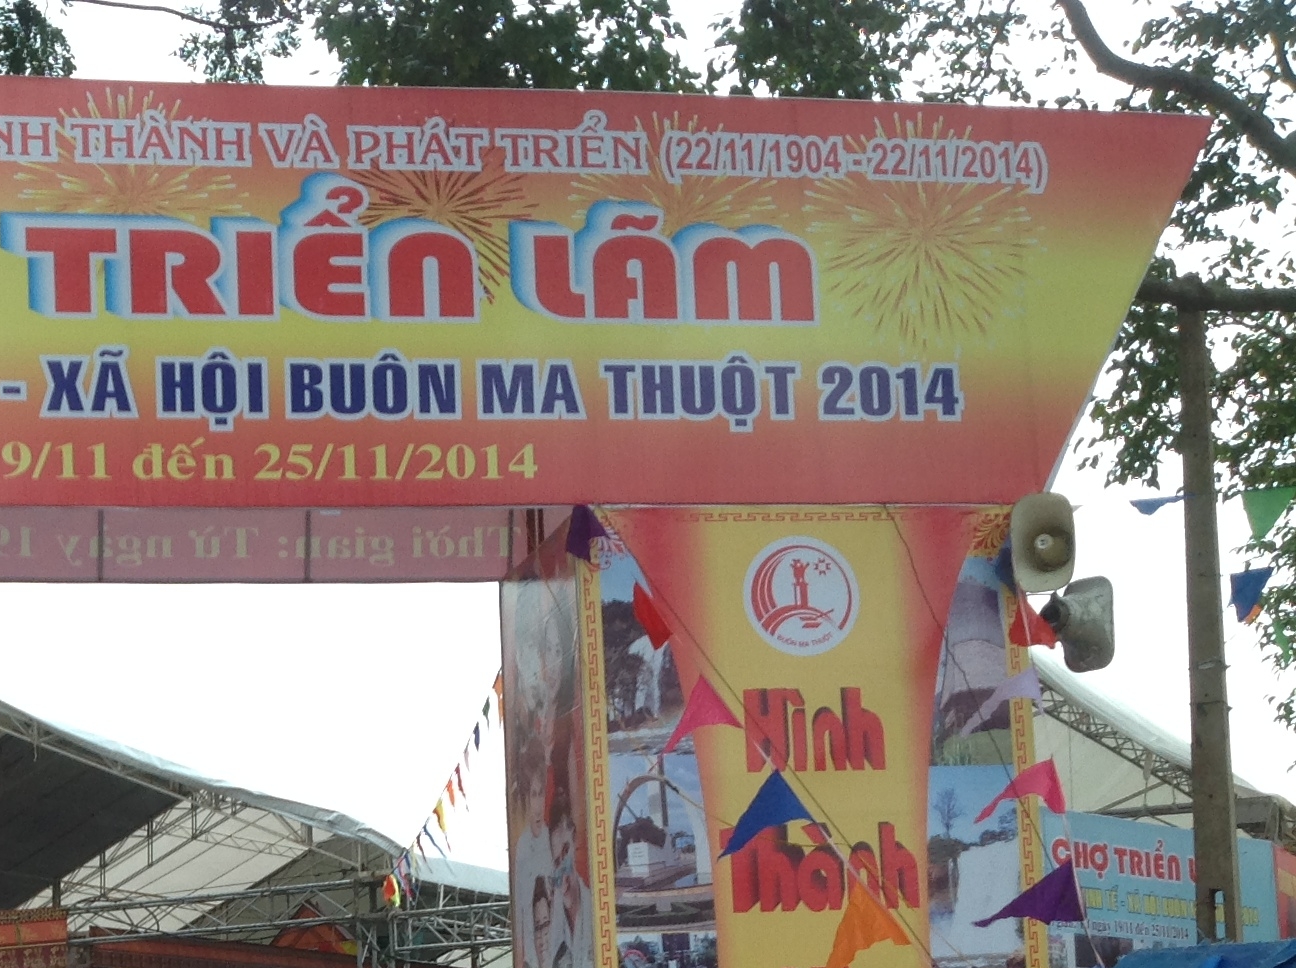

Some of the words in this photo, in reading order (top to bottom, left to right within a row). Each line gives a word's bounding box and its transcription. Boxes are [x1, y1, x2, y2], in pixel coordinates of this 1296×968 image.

[73, 107, 250, 167] THÀNH
[262, 116, 338, 168] VÀ
[350, 117, 487, 170] PHÁT
[499, 112, 647, 173] TRIỂN
[20, 182, 482, 320] TRIỂN
[529, 212, 819, 324] LÃM
[47, 350, 133, 416] XÃ
[160, 354, 268, 427] HỘI
[287, 352, 458, 418] BUÔN
[482, 362, 584, 418] MA
[605, 354, 798, 428] THUỘT
[821, 366, 961, 421] 2014
[131, 438, 236, 482] đến
[254, 443, 539, 487] 25/11/2014
[742, 686, 887, 774] Hình
[1051, 838, 1109, 879] CHỢ
[1113, 839, 1182, 882] TRIỂN
